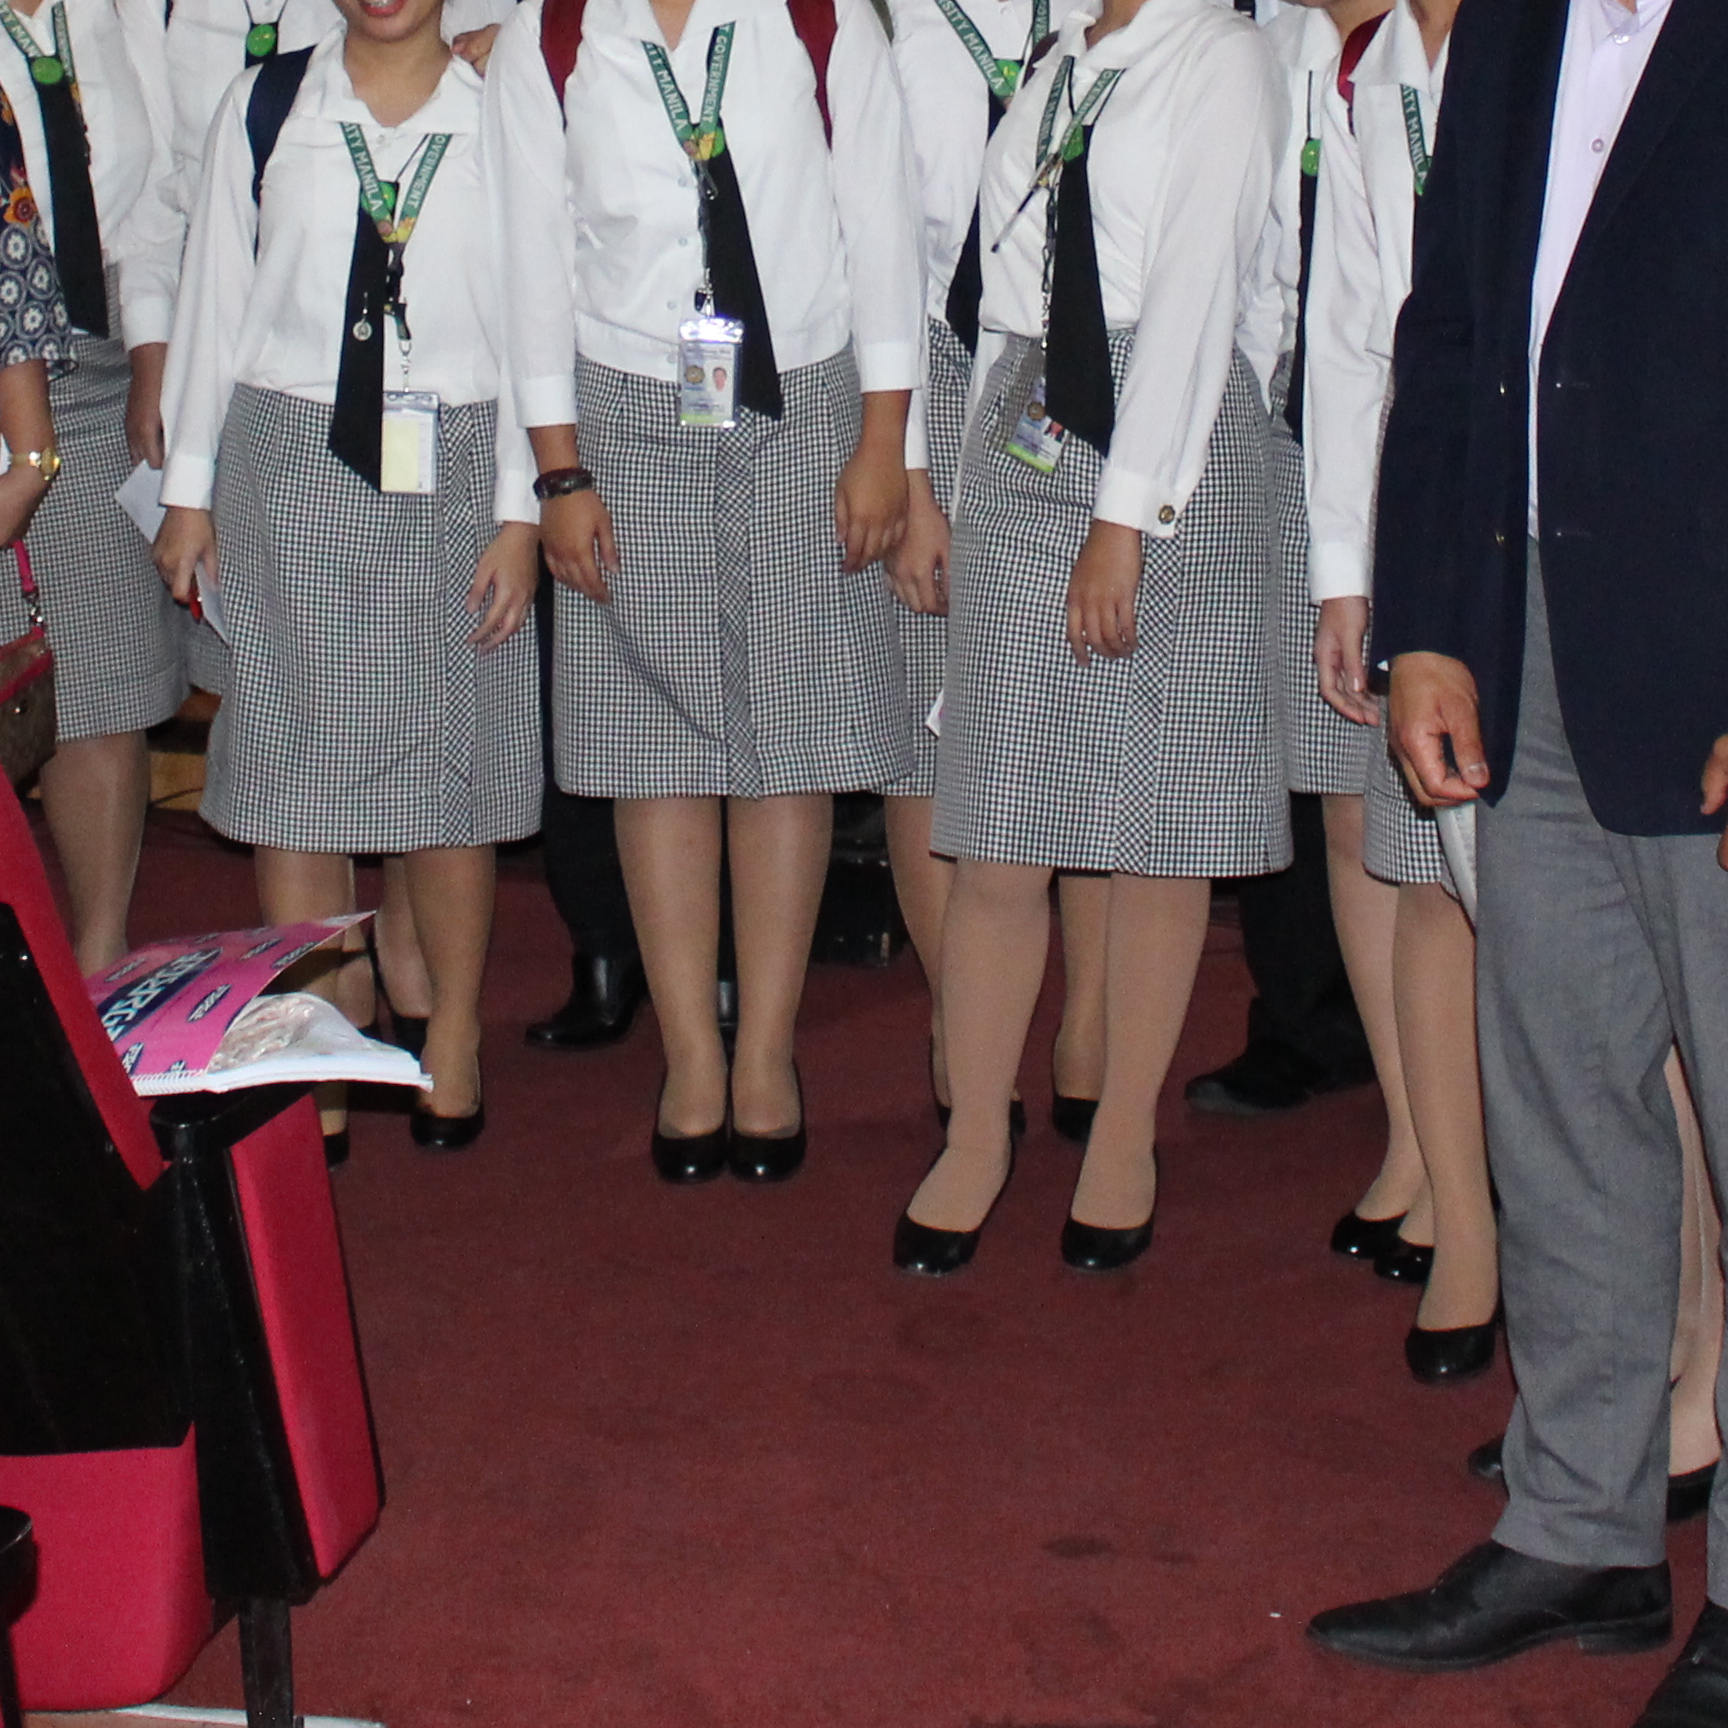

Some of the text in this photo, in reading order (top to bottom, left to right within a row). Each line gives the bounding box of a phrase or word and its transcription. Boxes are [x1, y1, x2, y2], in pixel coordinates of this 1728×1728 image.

[701, 34, 727, 123] GOVERNMENT
[964, 33, 1006, 90] MANILA
[656, 67, 689, 131] MANILA
[354, 151, 384, 212] MANILA
[406, 134, 446, 209] OVERNMENT
[1407, 116, 1428, 184] MANILA
